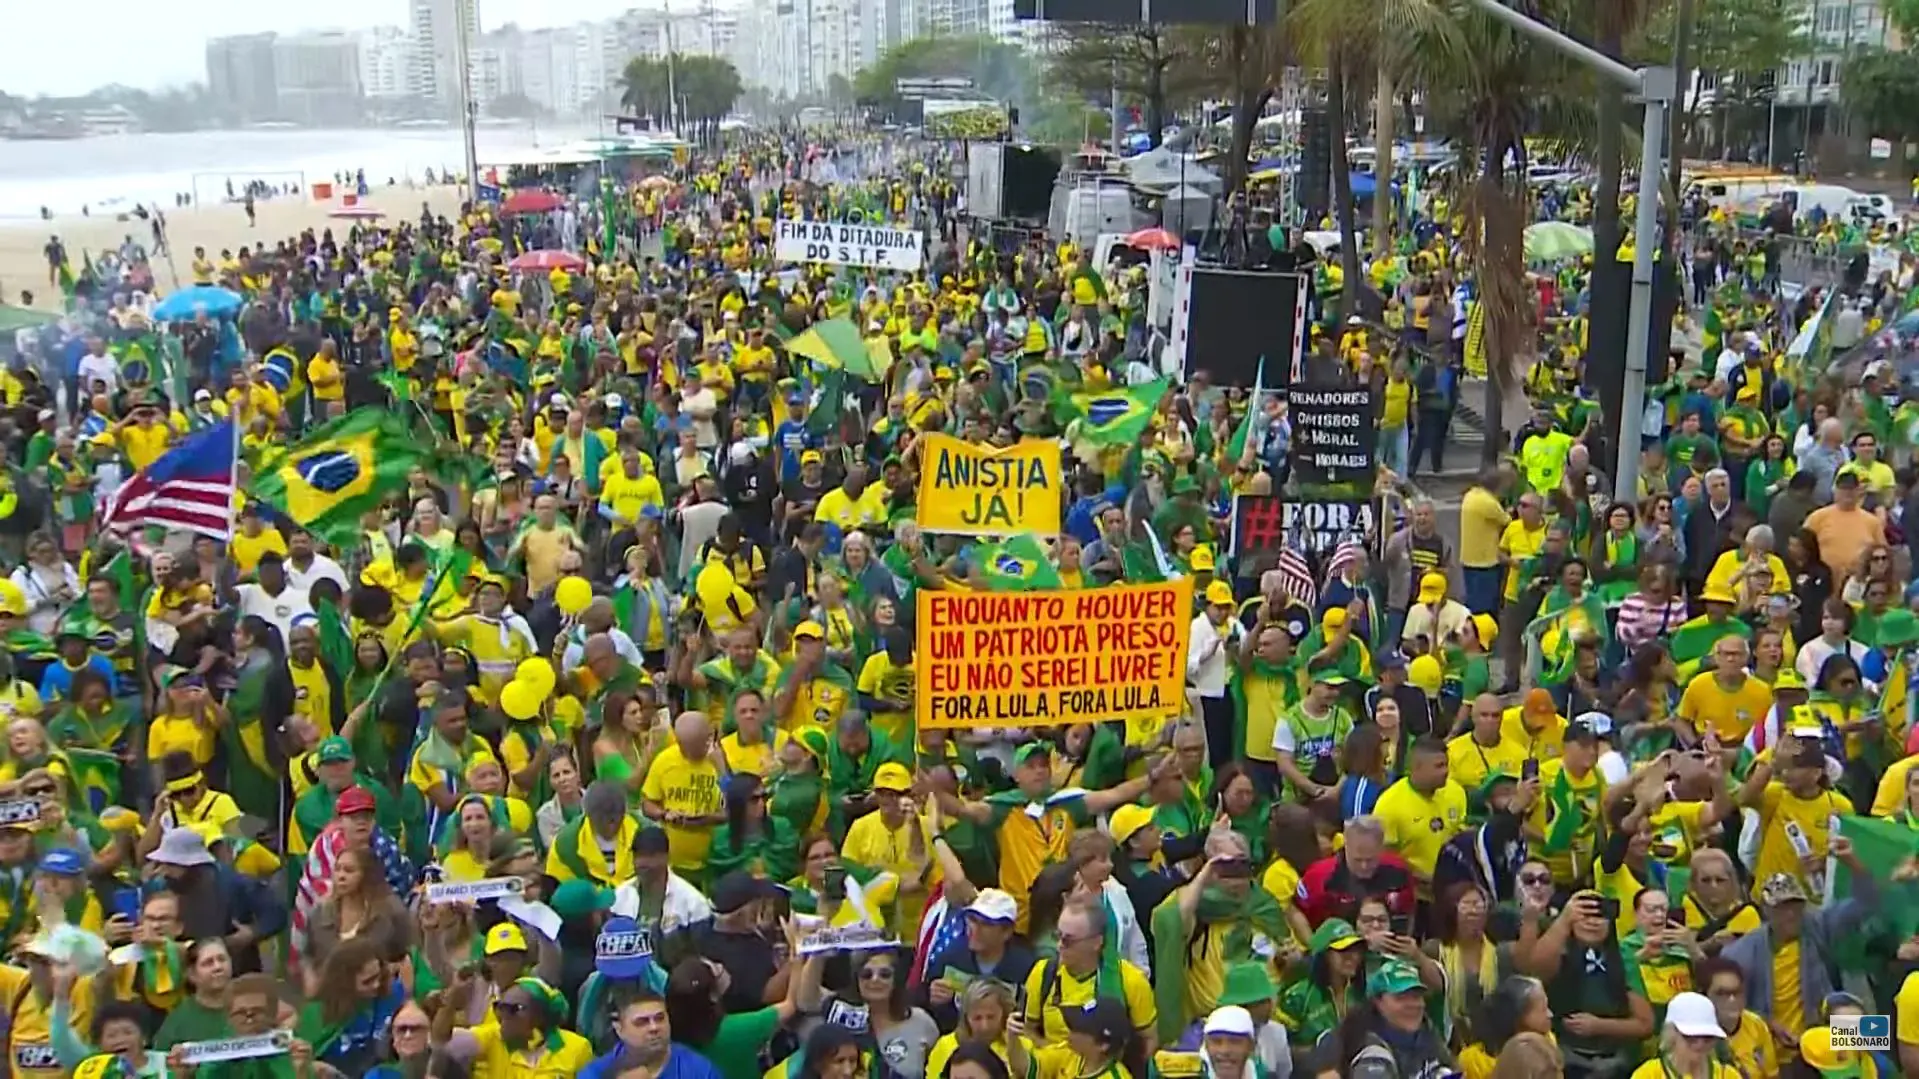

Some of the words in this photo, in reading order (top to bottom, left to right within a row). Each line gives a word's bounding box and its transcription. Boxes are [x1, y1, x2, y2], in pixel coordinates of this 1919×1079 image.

[781, 223, 807, 239] FIM
[812, 225, 833, 242] DA
[840, 228, 916, 249] DITADURA
[807, 244, 830, 259] DO
[839, 246, 891, 265] S.T.F.
[1290, 391, 1369, 405] SENADORES
[1298, 411, 1360, 428] OMISSOS
[1312, 429, 1359, 446] MORAL
[935, 448, 1048, 489] ANISTIA
[1315, 453, 1368, 468] MORAES
[931, 597, 1064, 626] ENQUANTO
[1077, 590, 1176, 620] HOUVER
[931, 631, 964, 659] UM
[975, 624, 1089, 658] PATRIOTA
[1098, 621, 1181, 652] PRESO,
[931, 664, 960, 692] EU
[968, 656, 1013, 690] NÃO
[1021, 657, 1087, 688] SEREI
[931, 696, 989, 720] FORA
[997, 691, 1056, 718] LULA,
[1059, 689, 1107, 714] FORA
